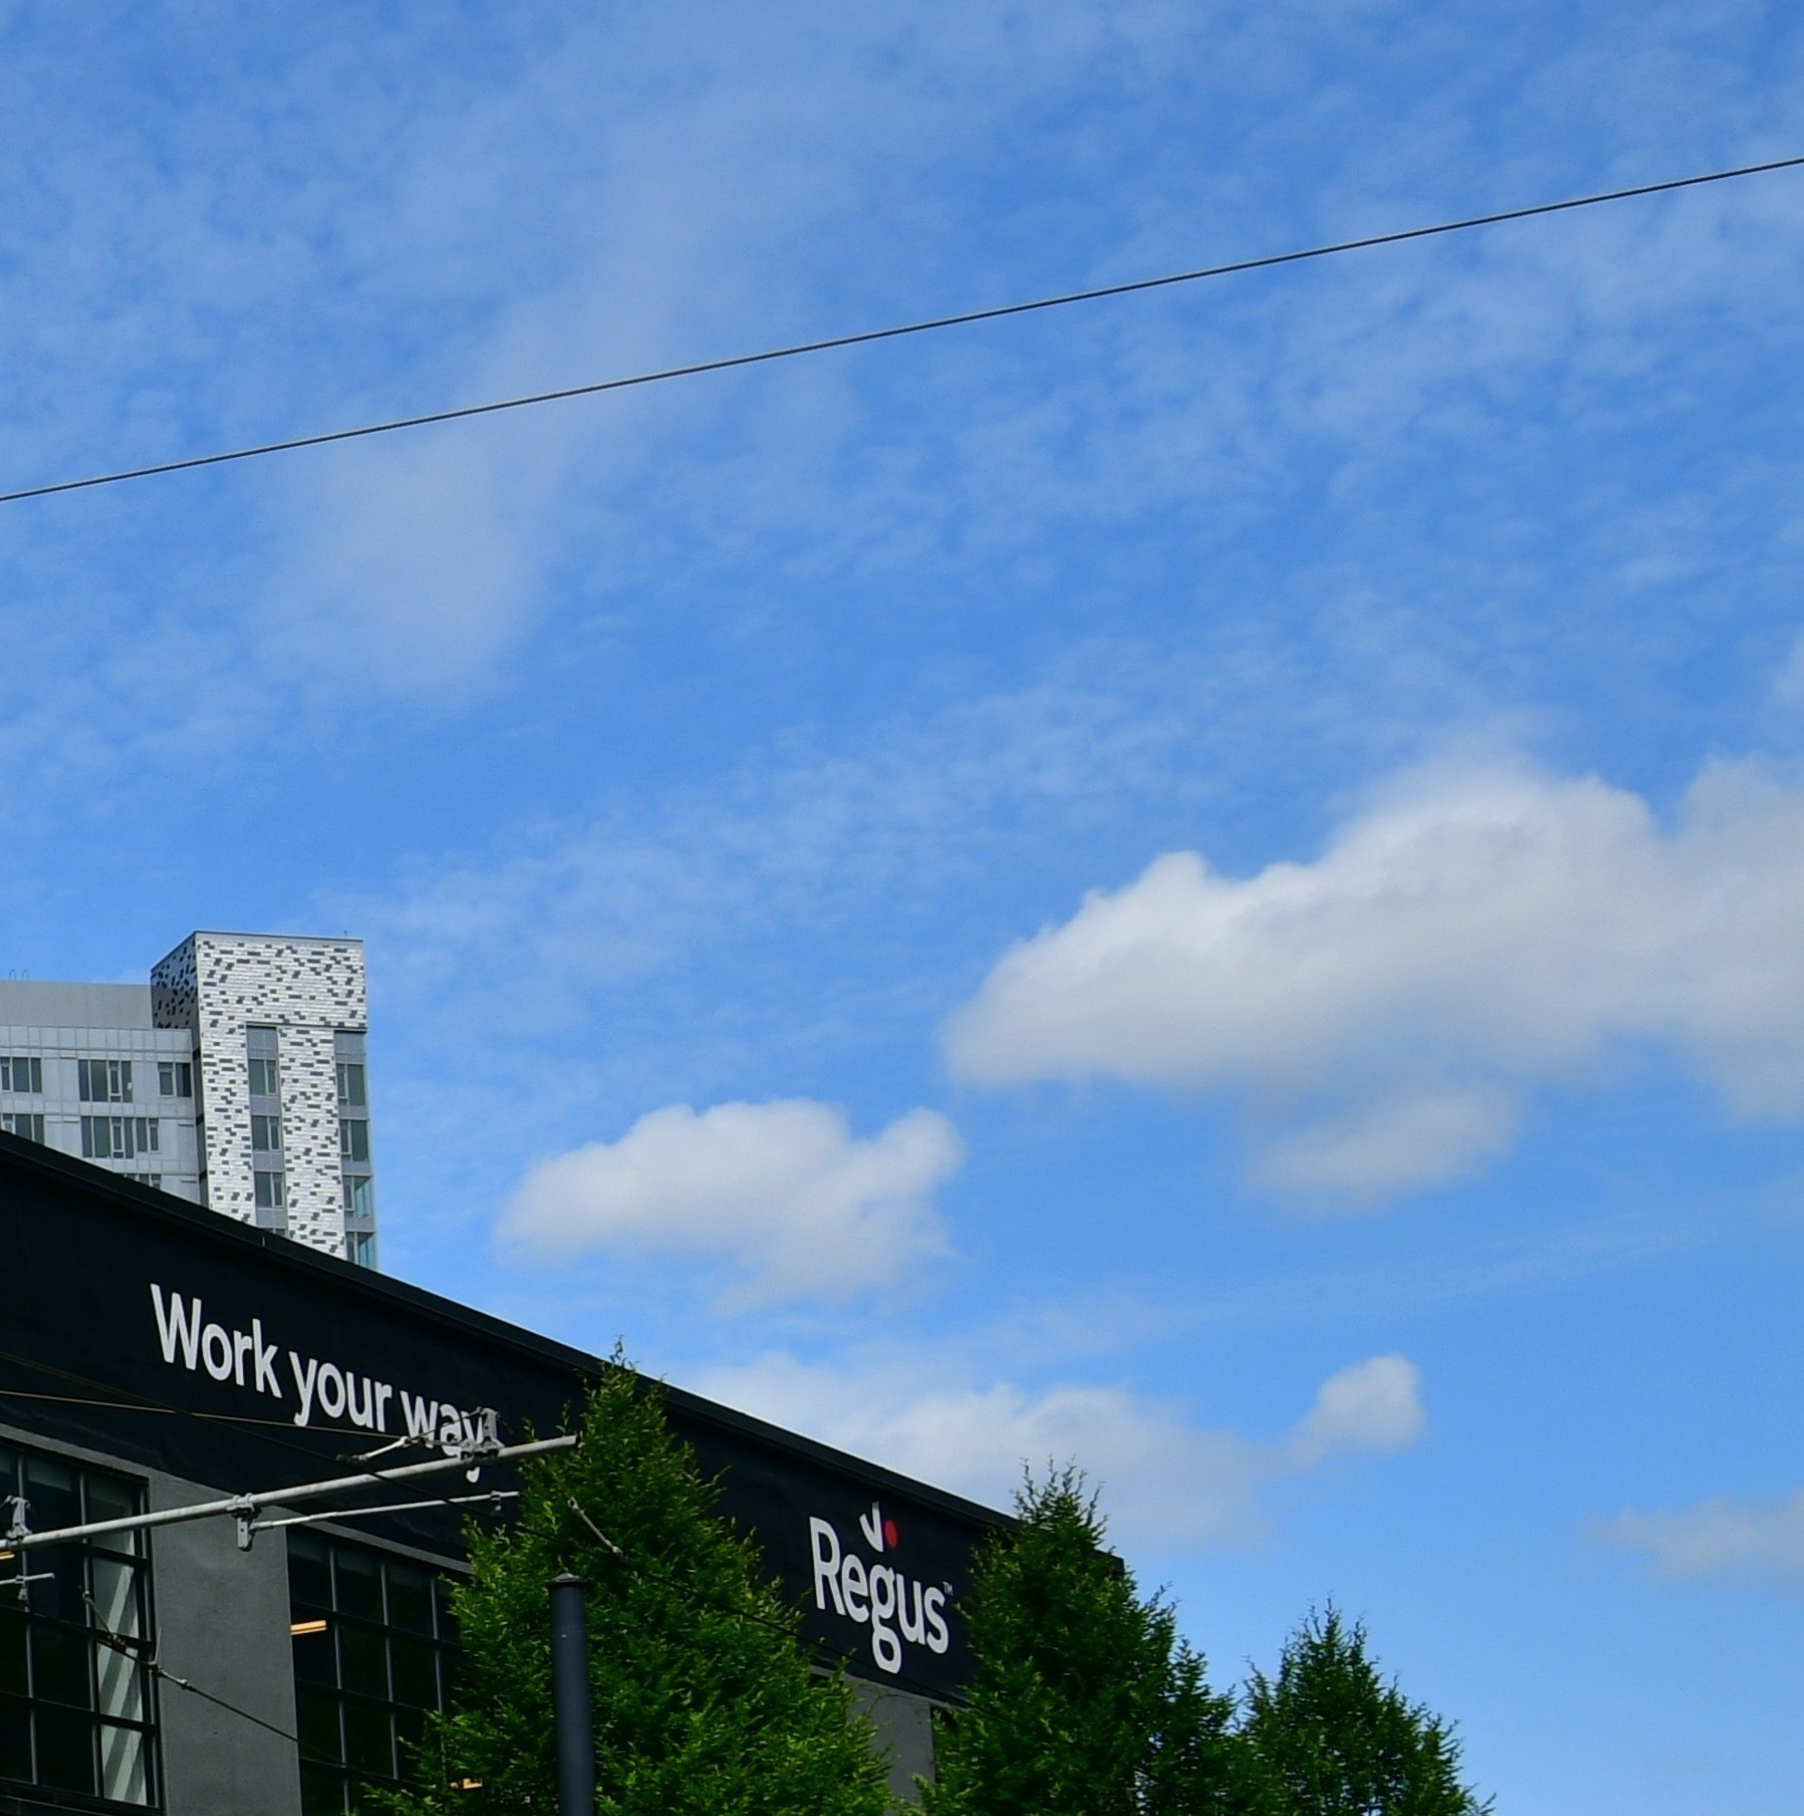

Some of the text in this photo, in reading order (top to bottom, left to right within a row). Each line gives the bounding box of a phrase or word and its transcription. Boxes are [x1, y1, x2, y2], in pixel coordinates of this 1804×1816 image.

[149, 1282, 283, 1398] Work
[289, 1350, 393, 1433] your
[809, 1515, 949, 1674] Regus
